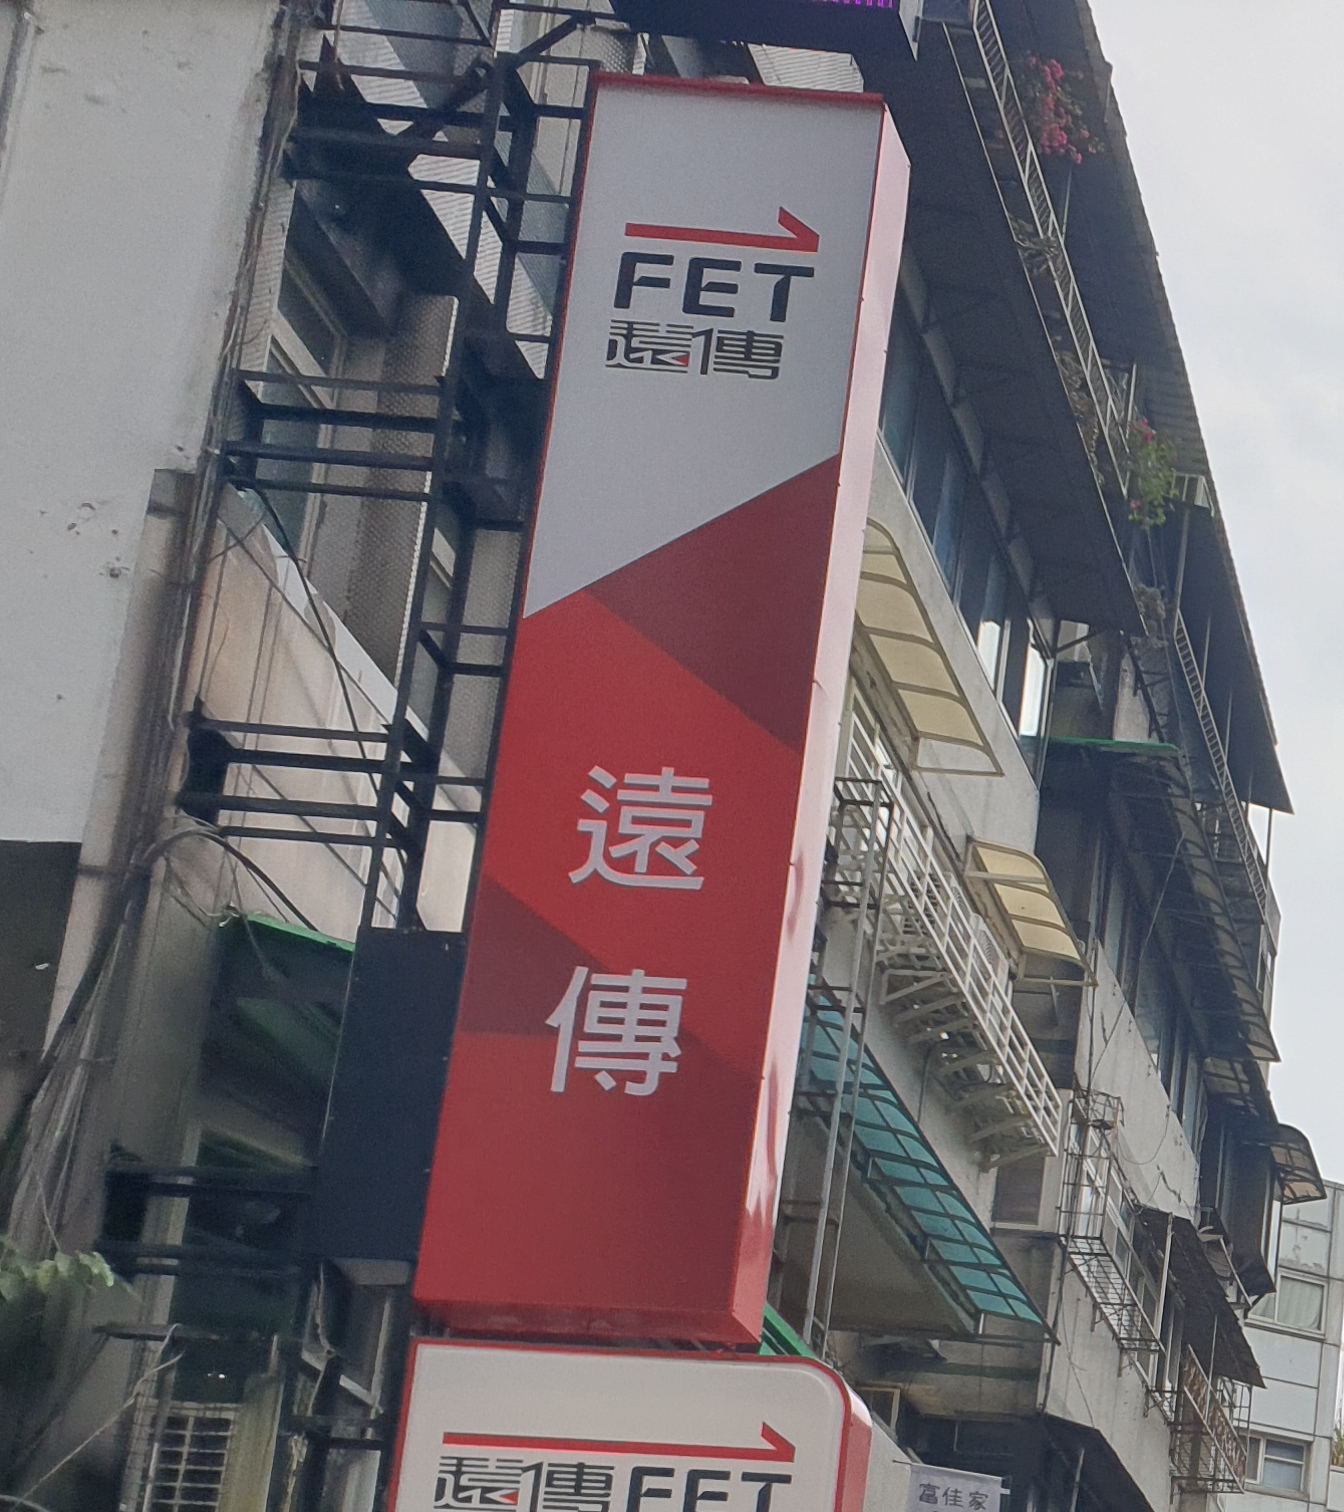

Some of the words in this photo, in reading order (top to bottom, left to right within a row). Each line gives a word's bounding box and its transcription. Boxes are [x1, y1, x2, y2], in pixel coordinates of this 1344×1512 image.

[613, 252, 815, 323] FET
[605, 320, 784, 380] 遠傳
[545, 766, 713, 1096] 遠傳
